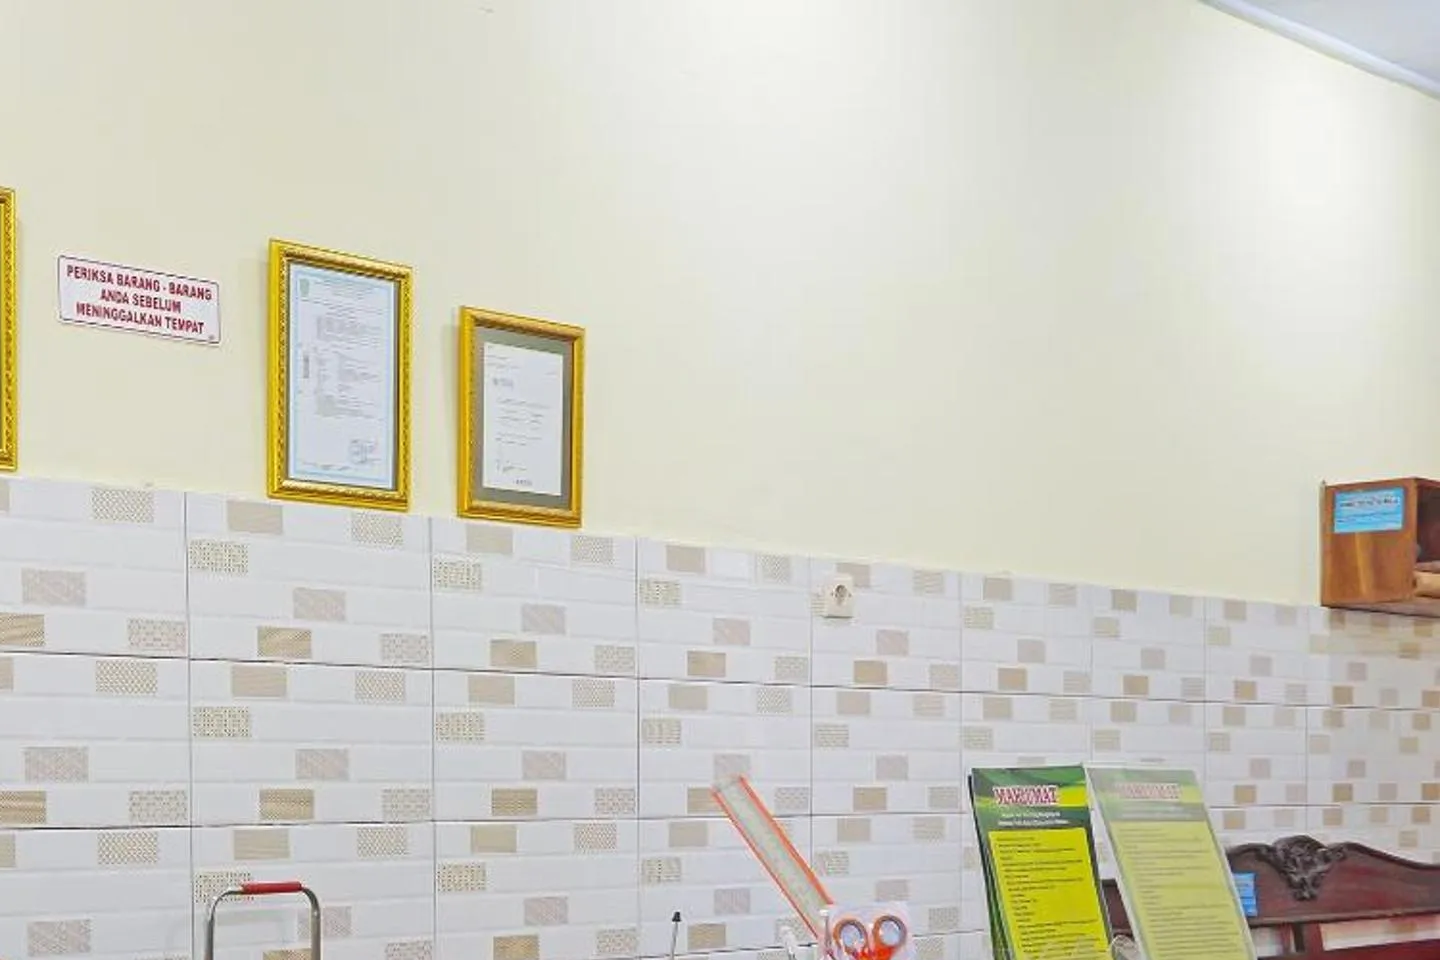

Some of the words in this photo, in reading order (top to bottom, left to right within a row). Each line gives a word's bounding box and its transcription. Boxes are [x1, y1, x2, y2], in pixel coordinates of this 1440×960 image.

[67, 264, 114, 285] PERIKSA
[116, 273, 160, 292] BARANG
[168, 282, 212, 300] BARANG
[100, 289, 129, 305] ANDA
[132, 293, 181, 313] SEBELUM
[76, 302, 162, 327] MENINGGALKAN
[164, 316, 204, 334] TEMPAT
